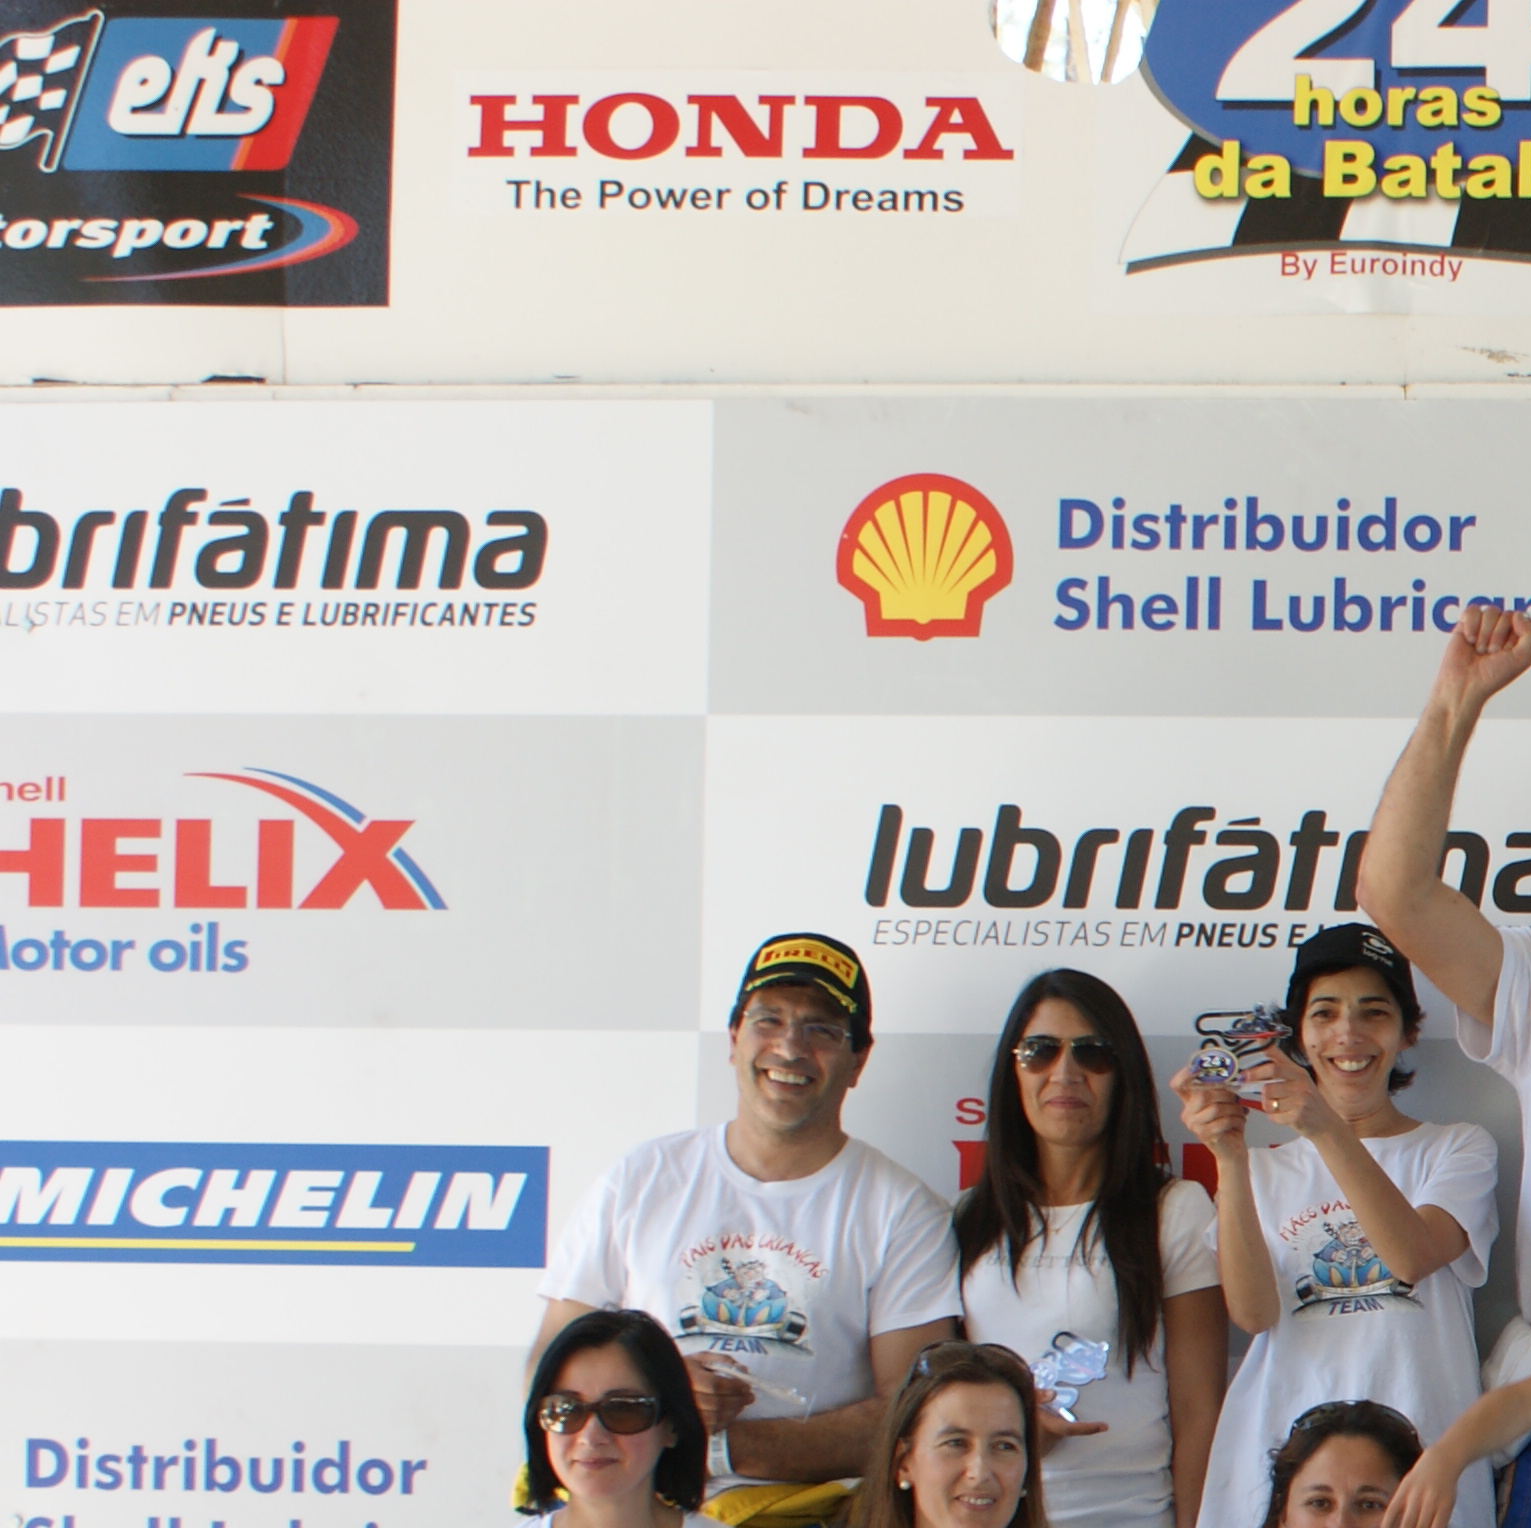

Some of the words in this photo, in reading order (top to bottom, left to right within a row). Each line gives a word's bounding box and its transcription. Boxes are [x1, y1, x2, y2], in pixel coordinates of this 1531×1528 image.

[467, 92, 1014, 161] HONDA
[1292, 74, 1502, 128] horas
[506, 180, 582, 211] The
[598, 180, 729, 212] Power
[745, 180, 787, 212] of
[802, 181, 965, 213] Dreams
[1193, 140, 1292, 200] da
[1280, 252, 1318, 281] By
[1328, 251, 1464, 281] Euroindy
[1056, 497, 1477, 553] Distribuidor
[115, 602, 162, 627] EM
[168, 602, 268, 627] PNEUS
[274, 603, 295, 627] E
[301, 602, 537, 628] LUBRIFICANTES
[1052, 577, 1222, 634] Shell
[0, 817, 432, 910] HELIX
[0, 921, 136, 972] otor
[147, 921, 250, 973] oils
[872, 920, 1112, 948] ESPECIALISTAS
[1120, 921, 1170, 948] EM
[1174, 922, 1279, 949] PNEUS
[1286, 923, 1308, 949] E
[0, 1167, 527, 1233] MICHELIN
[1327, 1297, 1385, 1317] TEAM
[707, 1336, 769, 1356] TEAM
[24, 1437, 427, 1496] Distribuidor
